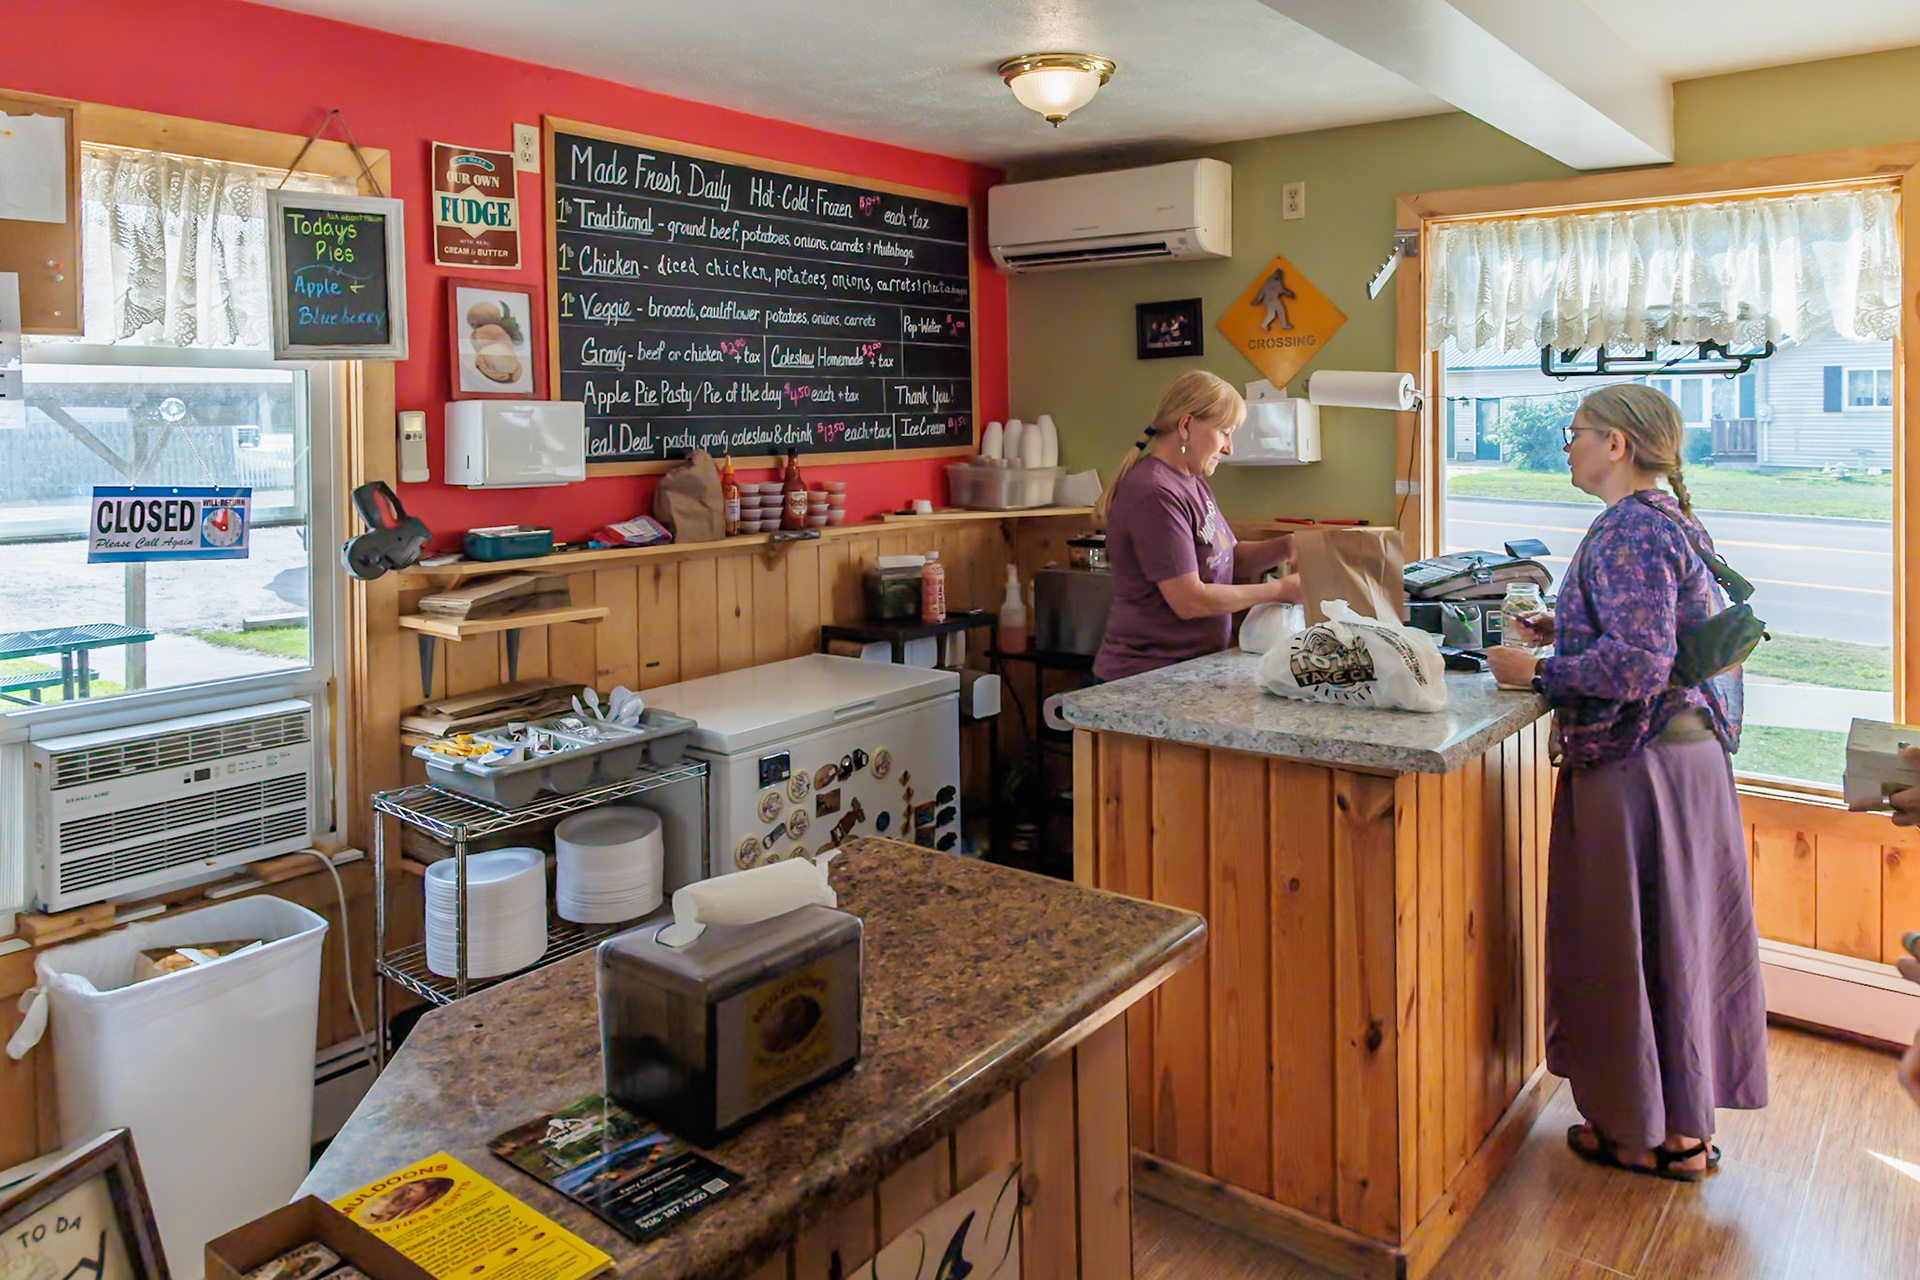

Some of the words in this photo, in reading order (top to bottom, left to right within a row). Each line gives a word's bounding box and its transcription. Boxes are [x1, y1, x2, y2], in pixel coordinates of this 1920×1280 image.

[446, 170, 471, 184] OUR
[473, 174, 500, 188] OWN
[571, 144, 628, 185] Made
[635, 154, 681, 194] Fresh
[687, 163, 731, 212] Daily
[884, 205, 907, 227] each
[440, 196, 511, 227] FUDGE
[286, 213, 357, 245] Todays
[573, 198, 654, 233] Traditional
[667, 216, 707, 243] ground
[830, 237, 864, 253] carrots
[873, 240, 914, 265] rhutabaga
[315, 240, 355, 263] Pies
[444, 246, 470, 255] CREAM
[477, 248, 509, 257] BUTTER
[657, 254, 700, 276] diced
[877, 277, 916, 294] carrots
[294, 275, 341, 298] Apple
[580, 293, 633, 327] Veggie
[844, 314, 876, 328] carrots
[638, 340, 665, 361] beef
[668, 350, 682, 361] or
[684, 343, 724, 363] chicken
[1247, 334, 1317, 351] CROSSING
[771, 344, 815, 367] Coleslaw
[817, 346, 864, 367] Homemade
[584, 380, 631, 414] Apple
[635, 380, 659, 405] Pie
[725, 382, 738, 403] of
[741, 383, 760, 402] the
[761, 382, 782, 411] day
[811, 384, 835, 402] each
[894, 385, 929, 406] Thank
[620, 422, 654, 454] Deal
[732, 425, 773, 447] coleslaw
[774, 424, 783, 444] &
[784, 423, 814, 446] drink
[845, 421, 869, 442] each
[203, 499, 218, 507] WILL
[220, 499, 245, 507] RETURN
[97, 500, 196, 534] CLOSED
[95, 538, 131, 550] Please
[135, 536, 159, 549] Call
[159, 537, 194, 549] Again
[1297, 670, 1347, 685] TAKE
[17, 1224, 46, 1248] TO
[56, 1216, 82, 1233] DA
